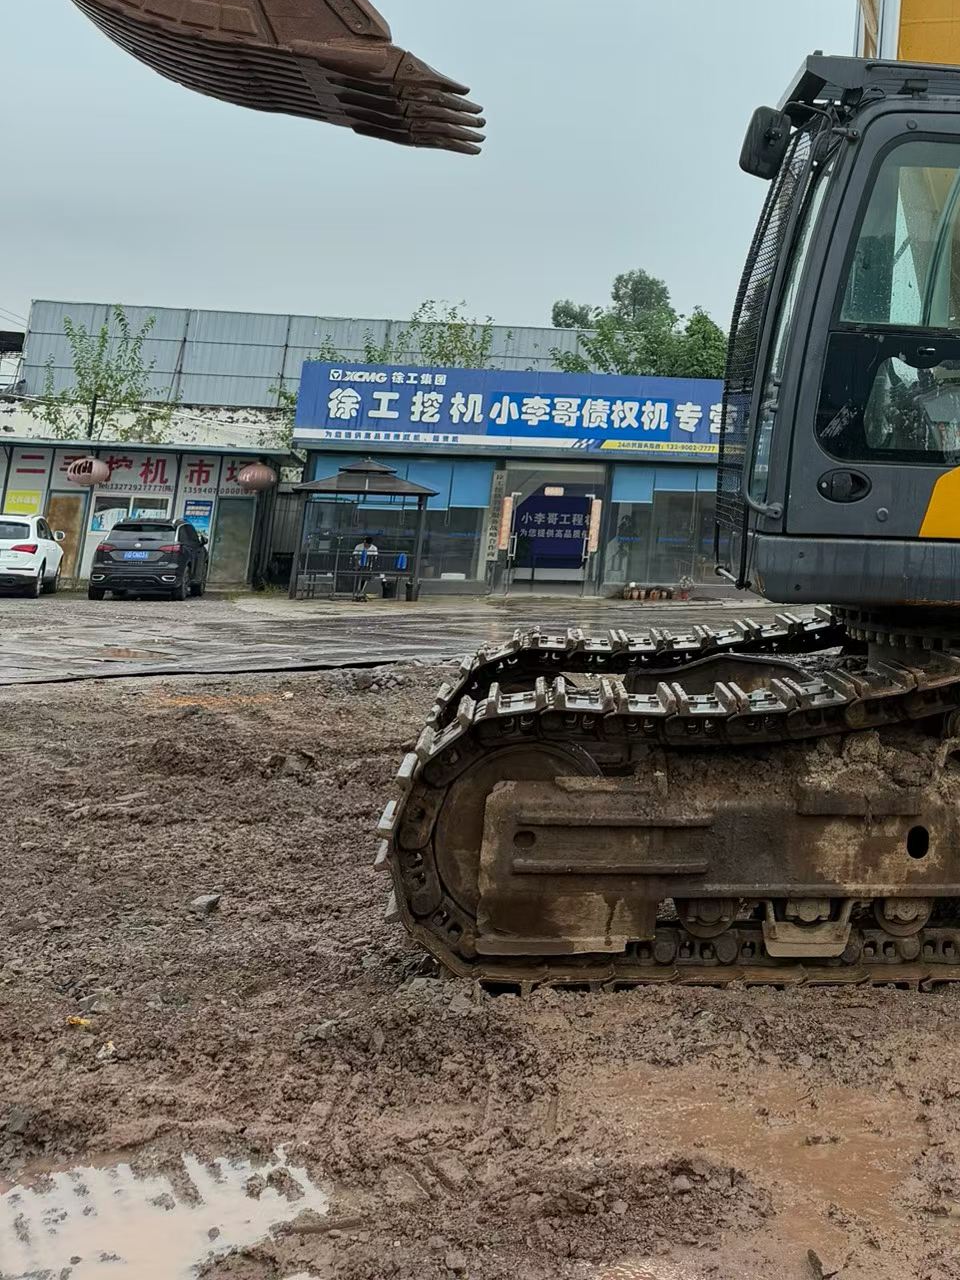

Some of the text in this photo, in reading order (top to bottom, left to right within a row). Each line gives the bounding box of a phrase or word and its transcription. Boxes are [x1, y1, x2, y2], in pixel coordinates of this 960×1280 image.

[344, 371, 447, 386] XCMG 徐工集团
